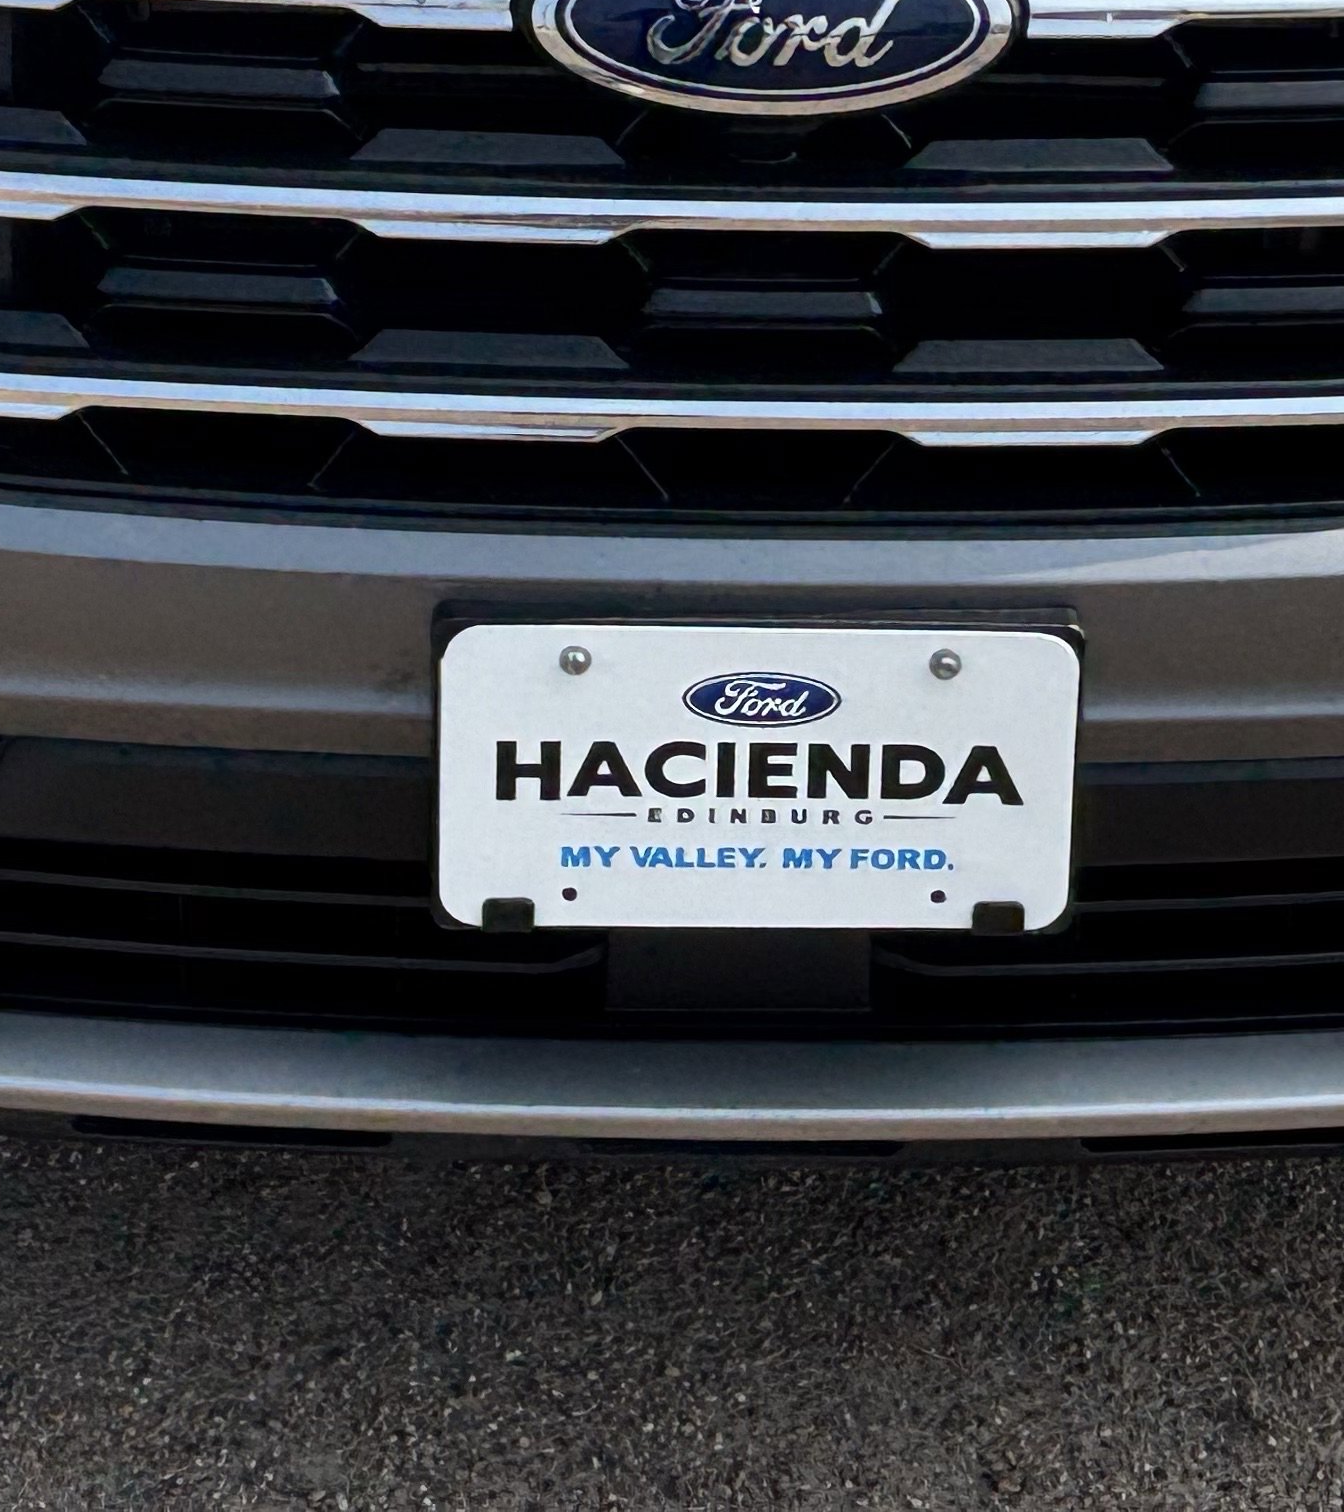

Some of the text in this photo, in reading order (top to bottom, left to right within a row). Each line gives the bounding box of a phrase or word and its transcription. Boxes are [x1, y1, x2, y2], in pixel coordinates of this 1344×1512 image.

[713, 679, 810, 718] Ford
[495, 739, 1024, 807] HACIENDA
[647, 807, 874, 825] EDINBURG
[560, 845, 955, 871] MY VALLEY. MY FORD.
